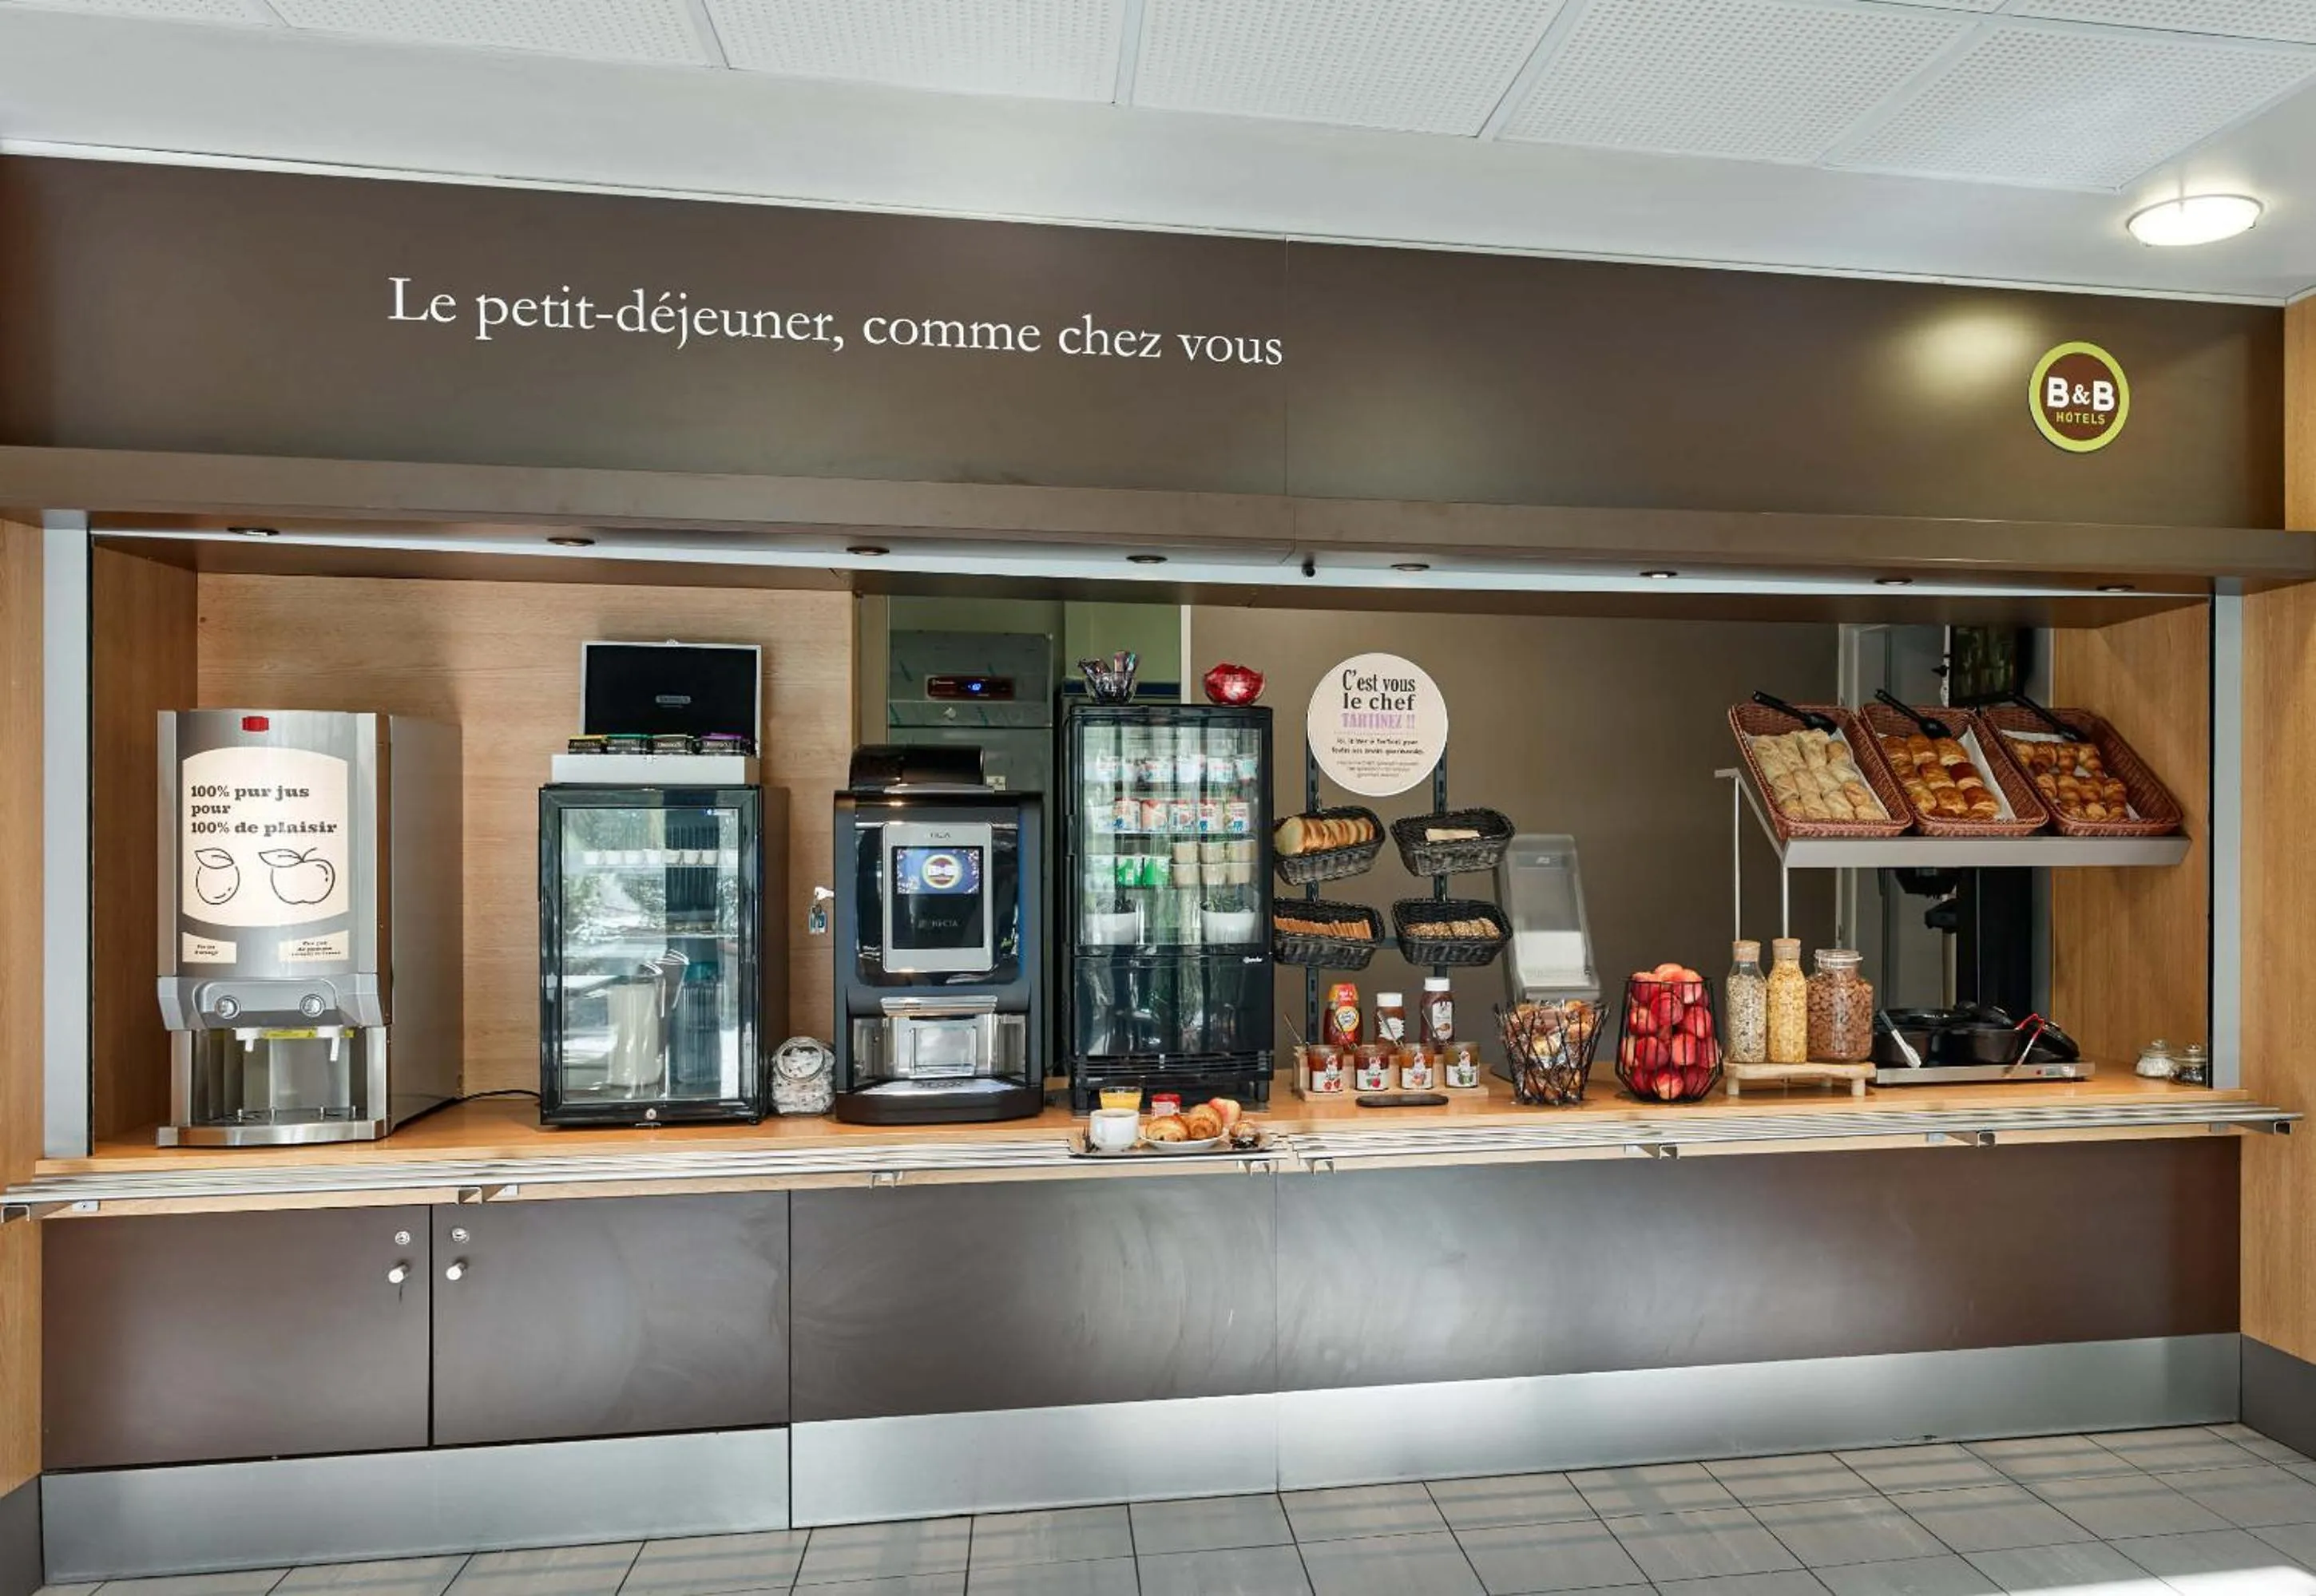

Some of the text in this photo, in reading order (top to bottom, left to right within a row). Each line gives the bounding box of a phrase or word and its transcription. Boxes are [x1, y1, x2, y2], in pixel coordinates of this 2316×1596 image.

[387, 277, 1283, 366] Le petit-déjeuner, comme chez vous
[2047, 376, 2115, 411] B&B
[2056, 411, 2106, 426] HOTELS
[1342, 669, 1416, 692] C'est vous
[1343, 692, 1417, 711] le chef
[191, 785, 310, 802] 100% pur jus
[191, 804, 231, 818] pour
[191, 821, 337, 838] 100% de plaisir
